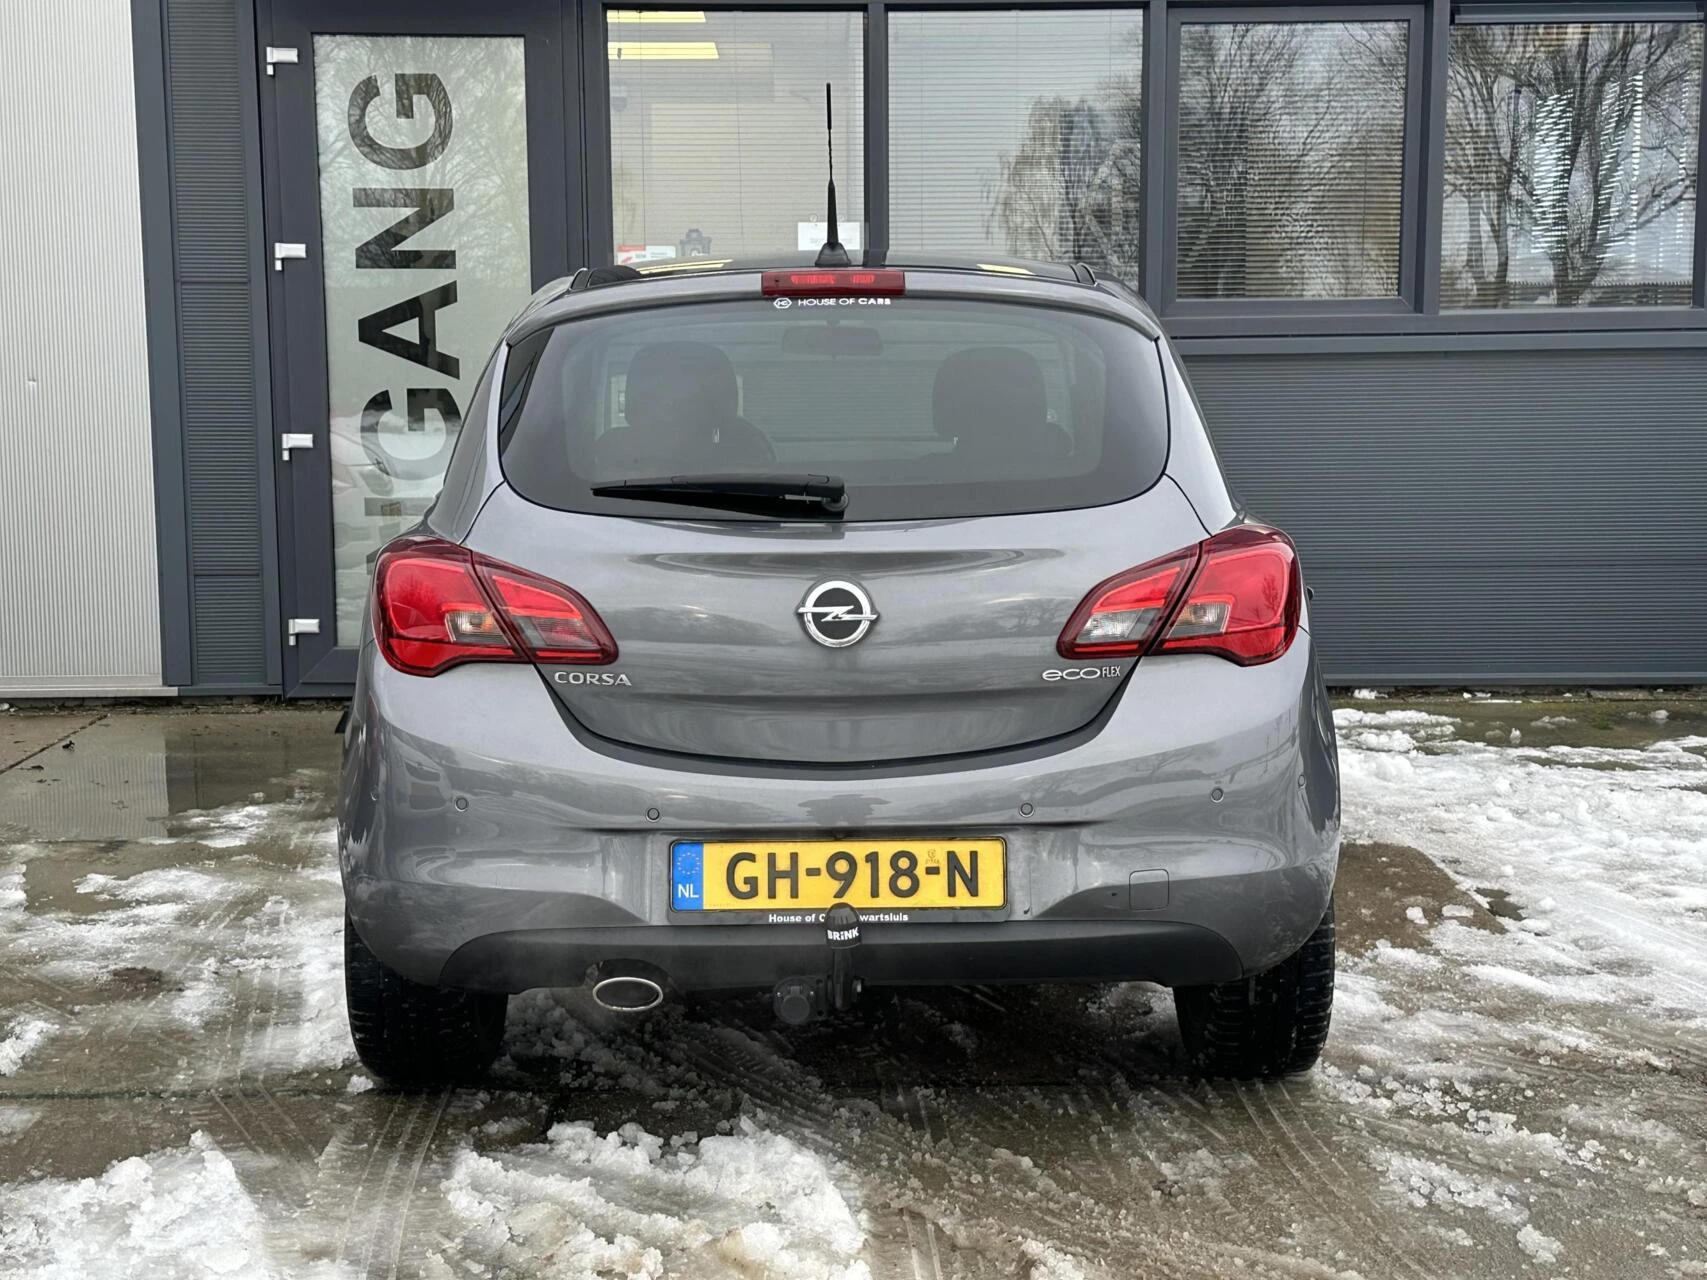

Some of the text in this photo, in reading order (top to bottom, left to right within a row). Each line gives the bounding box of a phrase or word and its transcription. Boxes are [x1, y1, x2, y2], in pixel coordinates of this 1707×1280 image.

[798, 298, 836, 306] HOUSE
[839, 298, 855, 306] OF
[554, 671, 632, 686] CORSA
[726, 851, 979, 899] GH-918-N
[677, 884, 699, 898] NL
[768, 914, 801, 922] House
[804, 914, 815, 922] of
[859, 912, 909, 921] wartsluis
